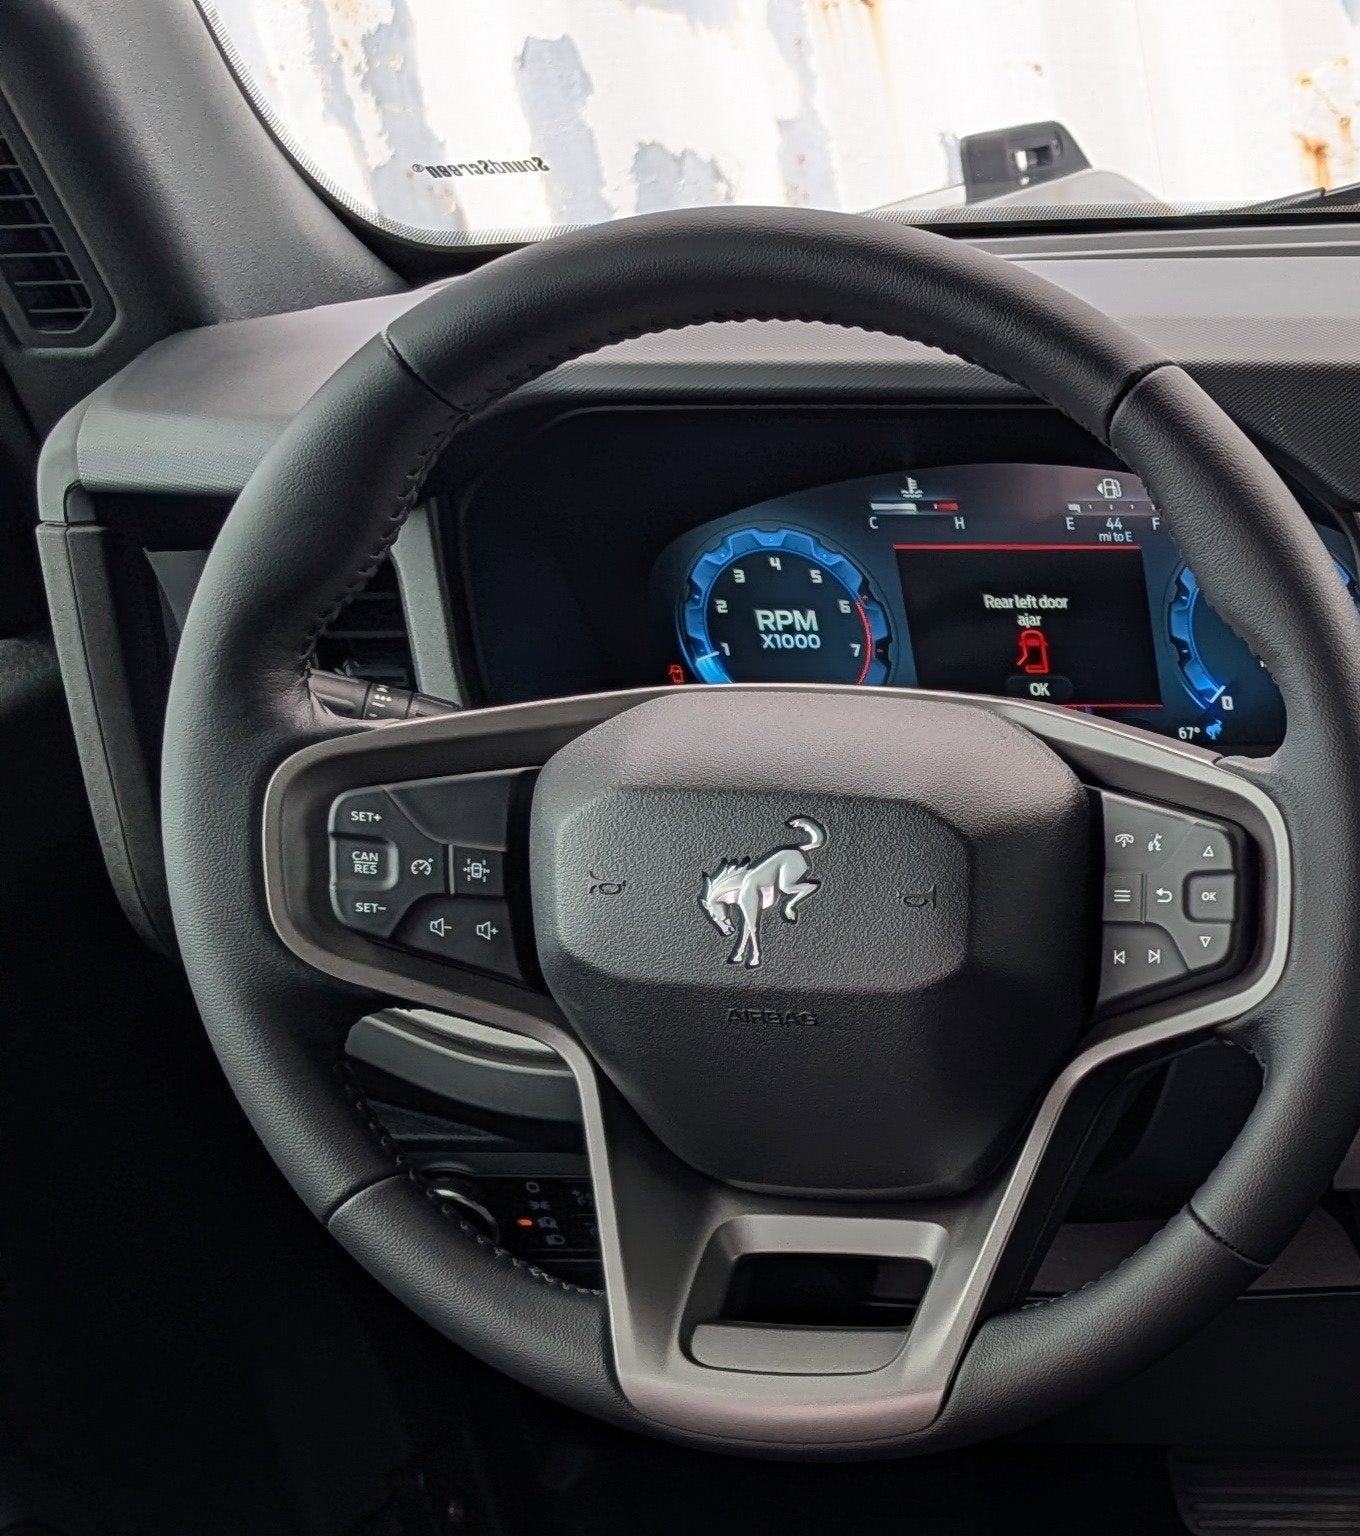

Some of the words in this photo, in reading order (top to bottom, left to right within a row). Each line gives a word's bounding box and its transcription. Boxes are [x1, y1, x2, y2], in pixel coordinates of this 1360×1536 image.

[868, 516, 879, 530] C
[953, 516, 966, 530] H
[1065, 516, 1076, 531] E
[1105, 517, 1123, 530] 44
[1151, 517, 1161, 531] F
[768, 556, 782, 571] 4
[732, 568, 746, 584] 3
[809, 568, 823, 584] 5
[715, 599, 729, 614] 2
[838, 599, 851, 614] 6
[982, 593, 1013, 609] Rear
[1013, 593, 1038, 609] left
[1038, 593, 1069, 610] door
[755, 608, 819, 632] RPM
[1017, 613, 1042, 628] ajar
[759, 633, 821, 650] X1000
[720, 642, 731, 657] 1
[849, 643, 861, 658] 7
[1029, 682, 1051, 697] OK
[1178, 726, 1201, 740] 67°
[350, 810, 383, 823] SET+
[351, 850, 379, 862] CAN
[353, 864, 378, 875] RES
[1201, 891, 1218, 902] OK
[727, 1008, 818, 1027] AIRBAG
